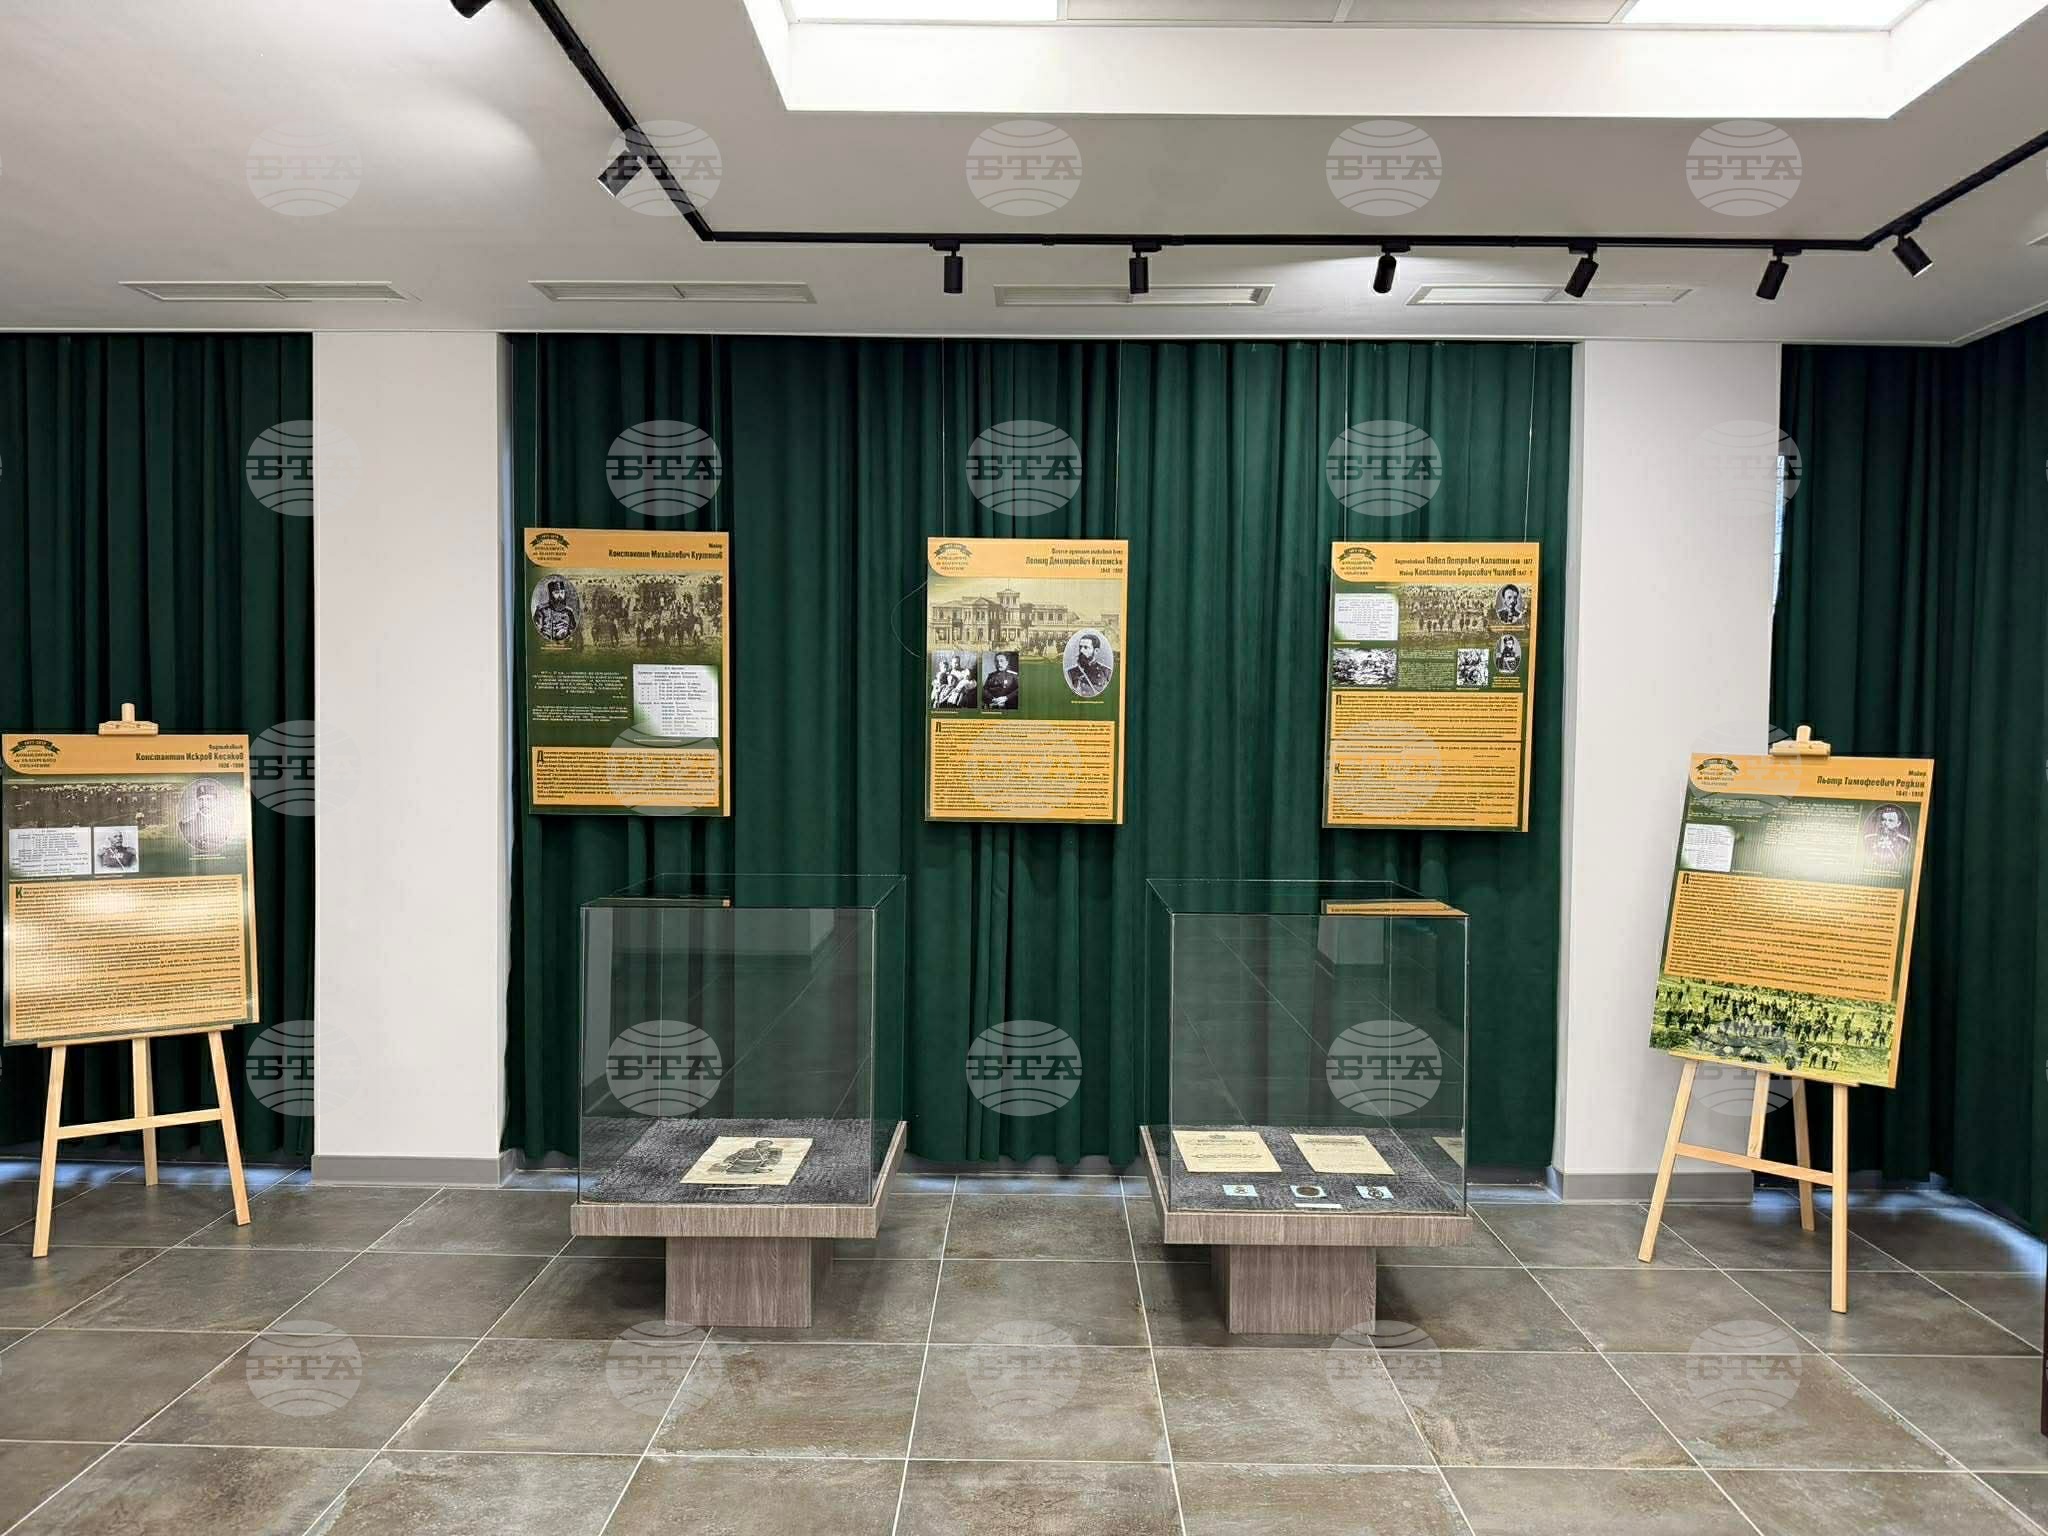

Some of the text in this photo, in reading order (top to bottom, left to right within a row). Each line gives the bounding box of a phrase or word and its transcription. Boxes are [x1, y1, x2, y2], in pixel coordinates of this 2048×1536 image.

[608, 549, 650, 559] Константин
[651, 550, 691, 560] Михайлович
[1426, 556, 1446, 565] Павел
[1446, 556, 1480, 566] Петрович
[1480, 556, 1510, 565] Калитин
[1414, 568, 1457, 577] Константин
[1457, 568, 1492, 578] Борисович
[136, 752, 243, 762] Константин Искров Кесяков
[1844, 776, 1895, 788] Тимофеевич
[1896, 779, 1926, 789] Редкин
